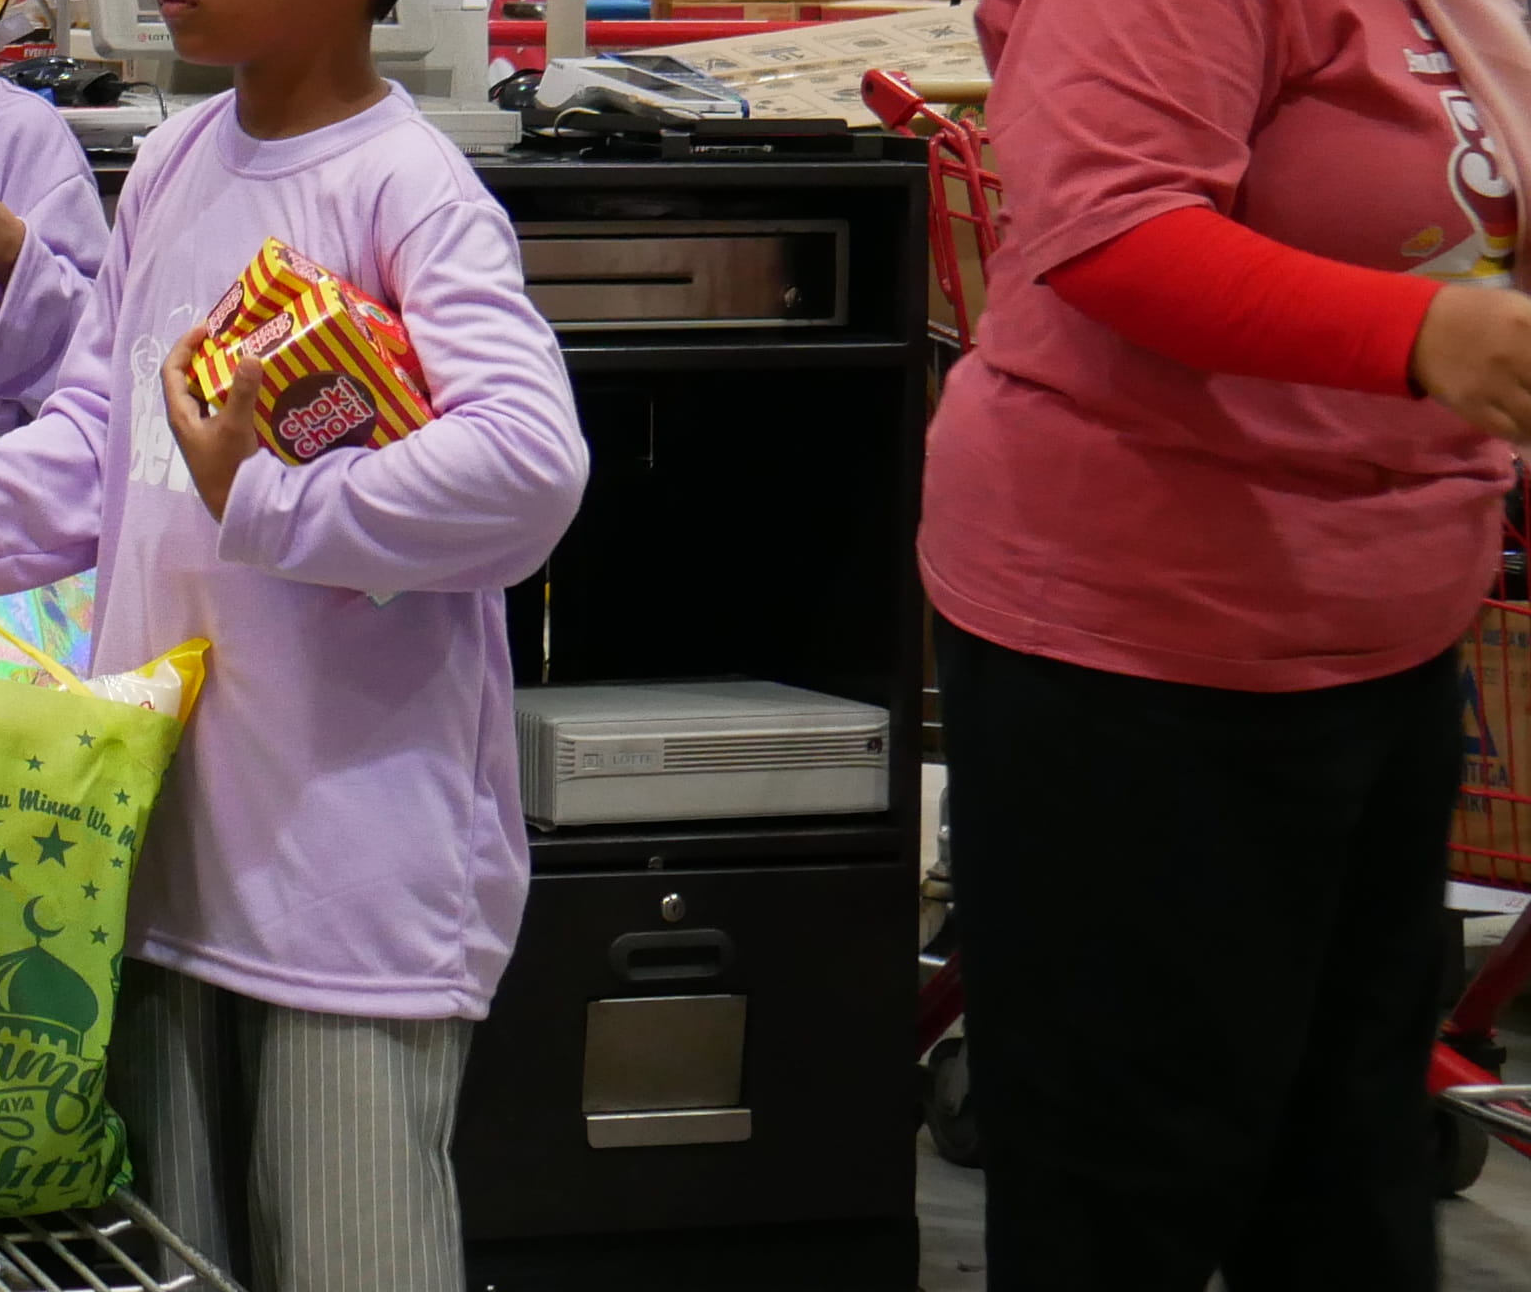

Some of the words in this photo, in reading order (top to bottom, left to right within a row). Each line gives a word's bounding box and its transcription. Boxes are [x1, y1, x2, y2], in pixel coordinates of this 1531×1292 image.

[279, 375, 359, 441] choki
[294, 397, 375, 459] choki
[19, 788, 82, 822] Minna
[86, 806, 112, 838] Wa
